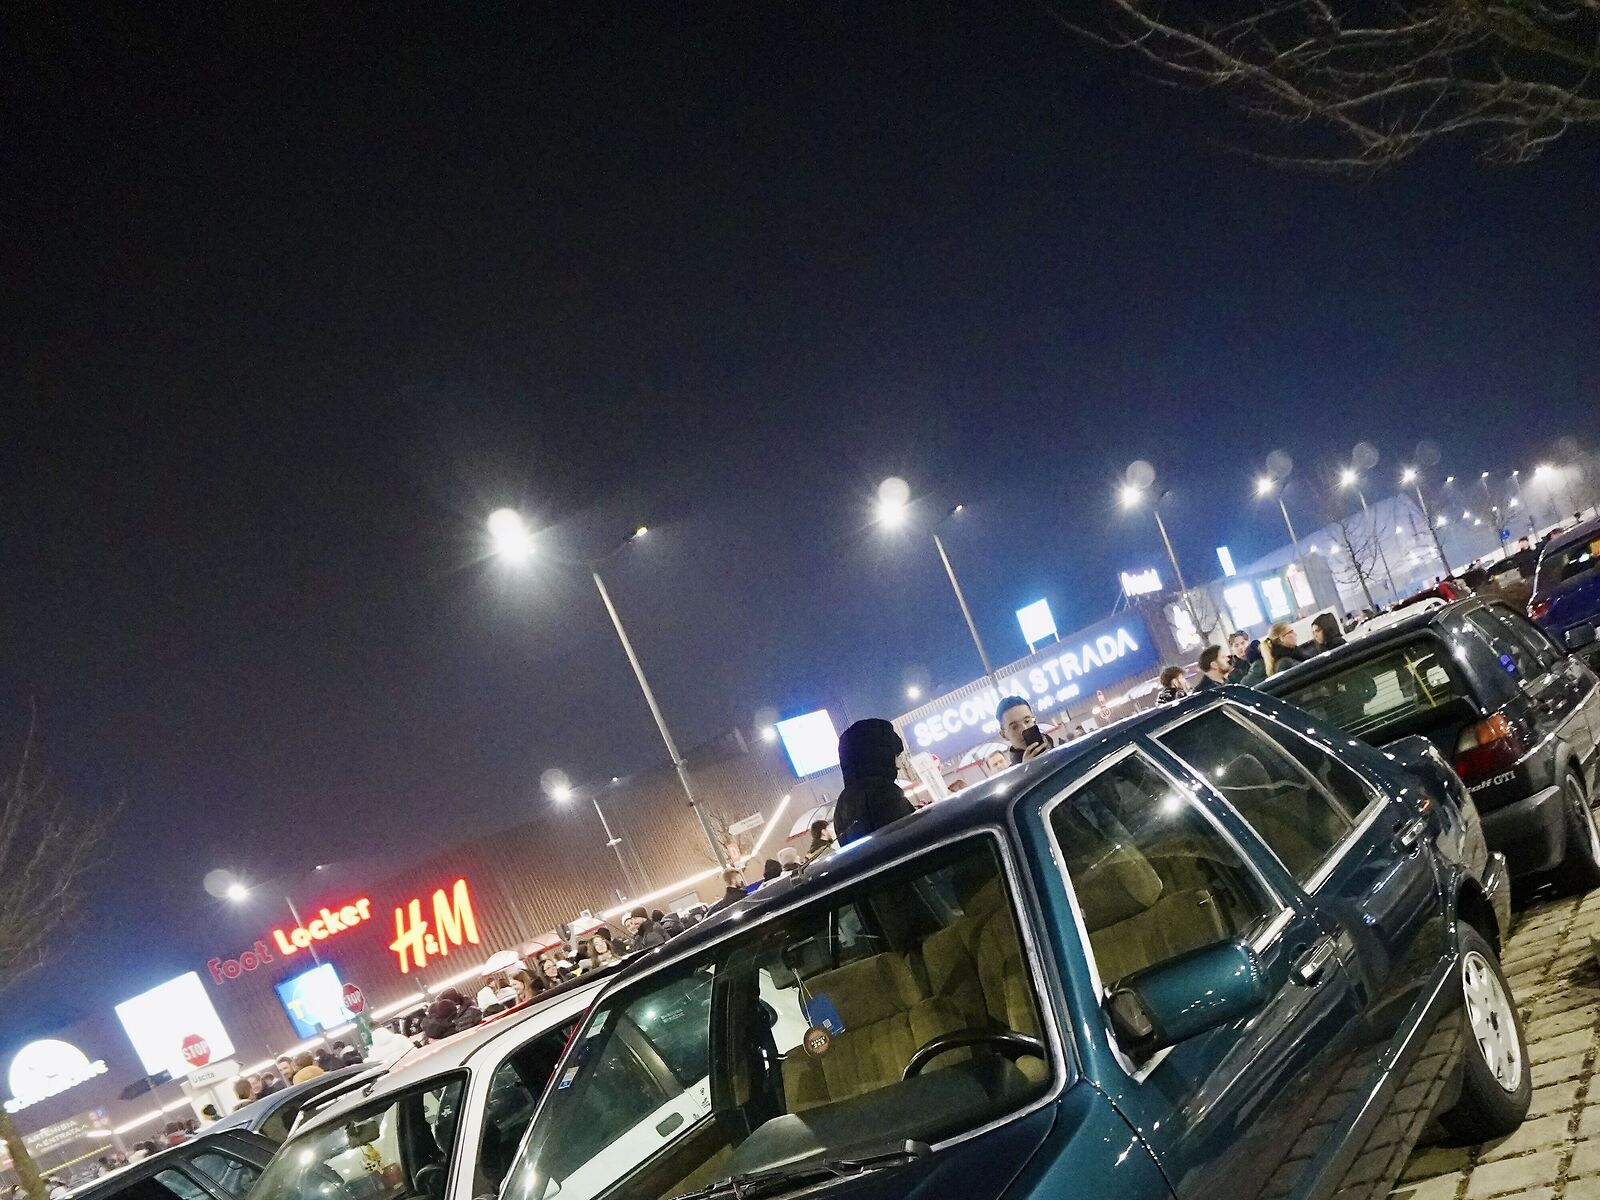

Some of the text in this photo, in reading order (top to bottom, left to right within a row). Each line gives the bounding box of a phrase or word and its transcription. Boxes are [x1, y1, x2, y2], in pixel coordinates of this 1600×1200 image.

[1028, 628, 1139, 694] STRADA
[1493, 770, 1517, 785] GTI
[388, 878, 480, 974] H&M
[207, 897, 371, 985] Foot Locker
[343, 990, 362, 1008] STOP
[182, 1039, 209, 1060] STOP
[42, 1127, 81, 1145] ENTRATA
